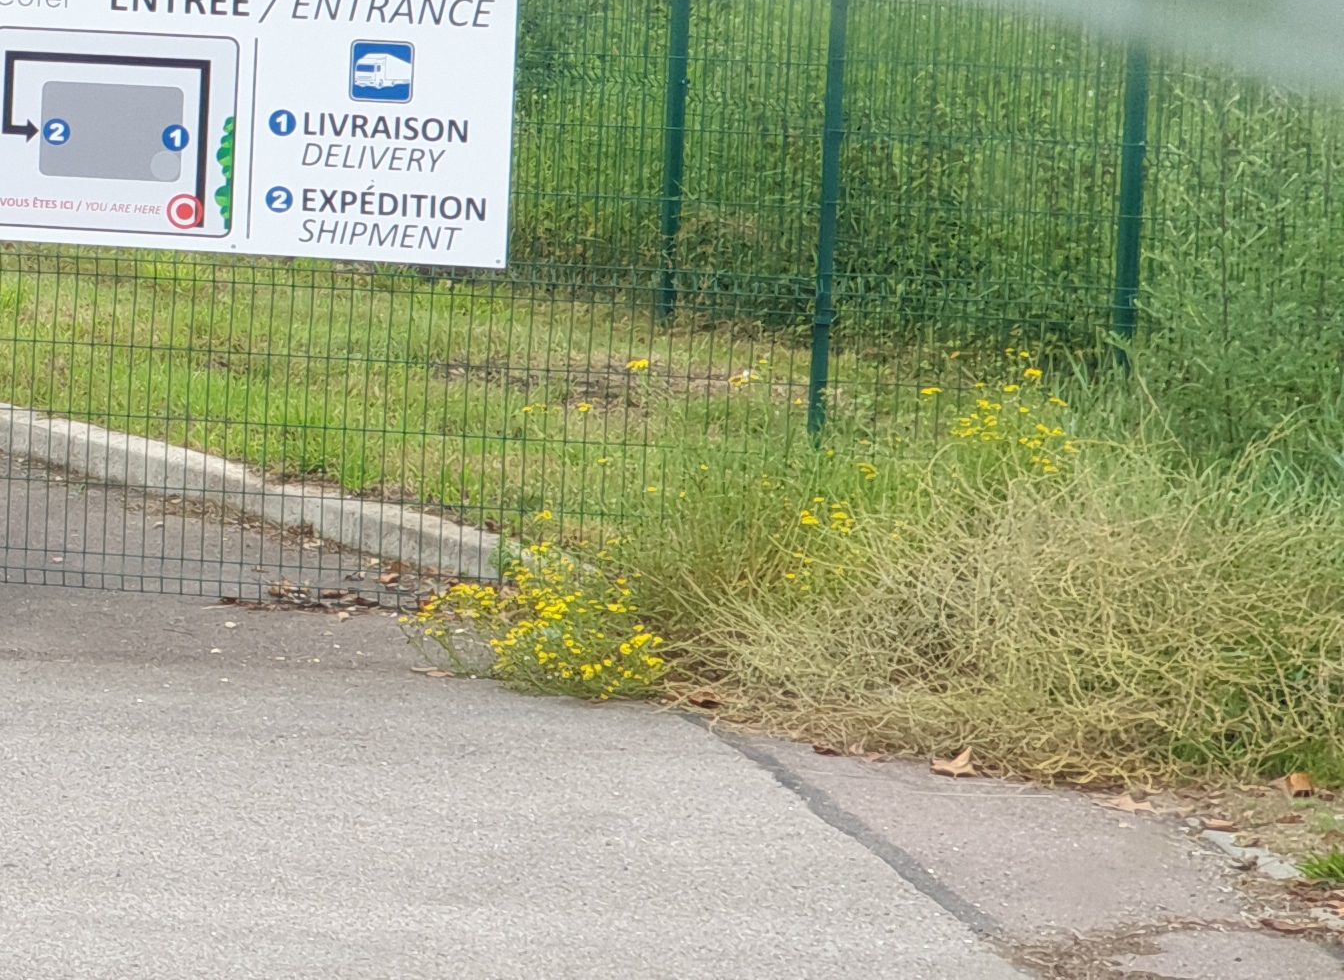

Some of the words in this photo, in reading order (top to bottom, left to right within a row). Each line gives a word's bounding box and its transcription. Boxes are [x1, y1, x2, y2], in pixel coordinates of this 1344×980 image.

[302, 111, 469, 143] LIVRAISON
[301, 142, 446, 173] DELIVERY
[0, 197, 30, 208] VOUS
[33, 196, 57, 209] ÊTES
[60, 200, 73, 210] ICI
[85, 201, 108, 212] YOU
[110, 203, 131, 213] ARE
[134, 204, 162, 215] HERE
[301, 184, 488, 222] EXPÉDITION
[298, 220, 462, 251] SHIPMENT
